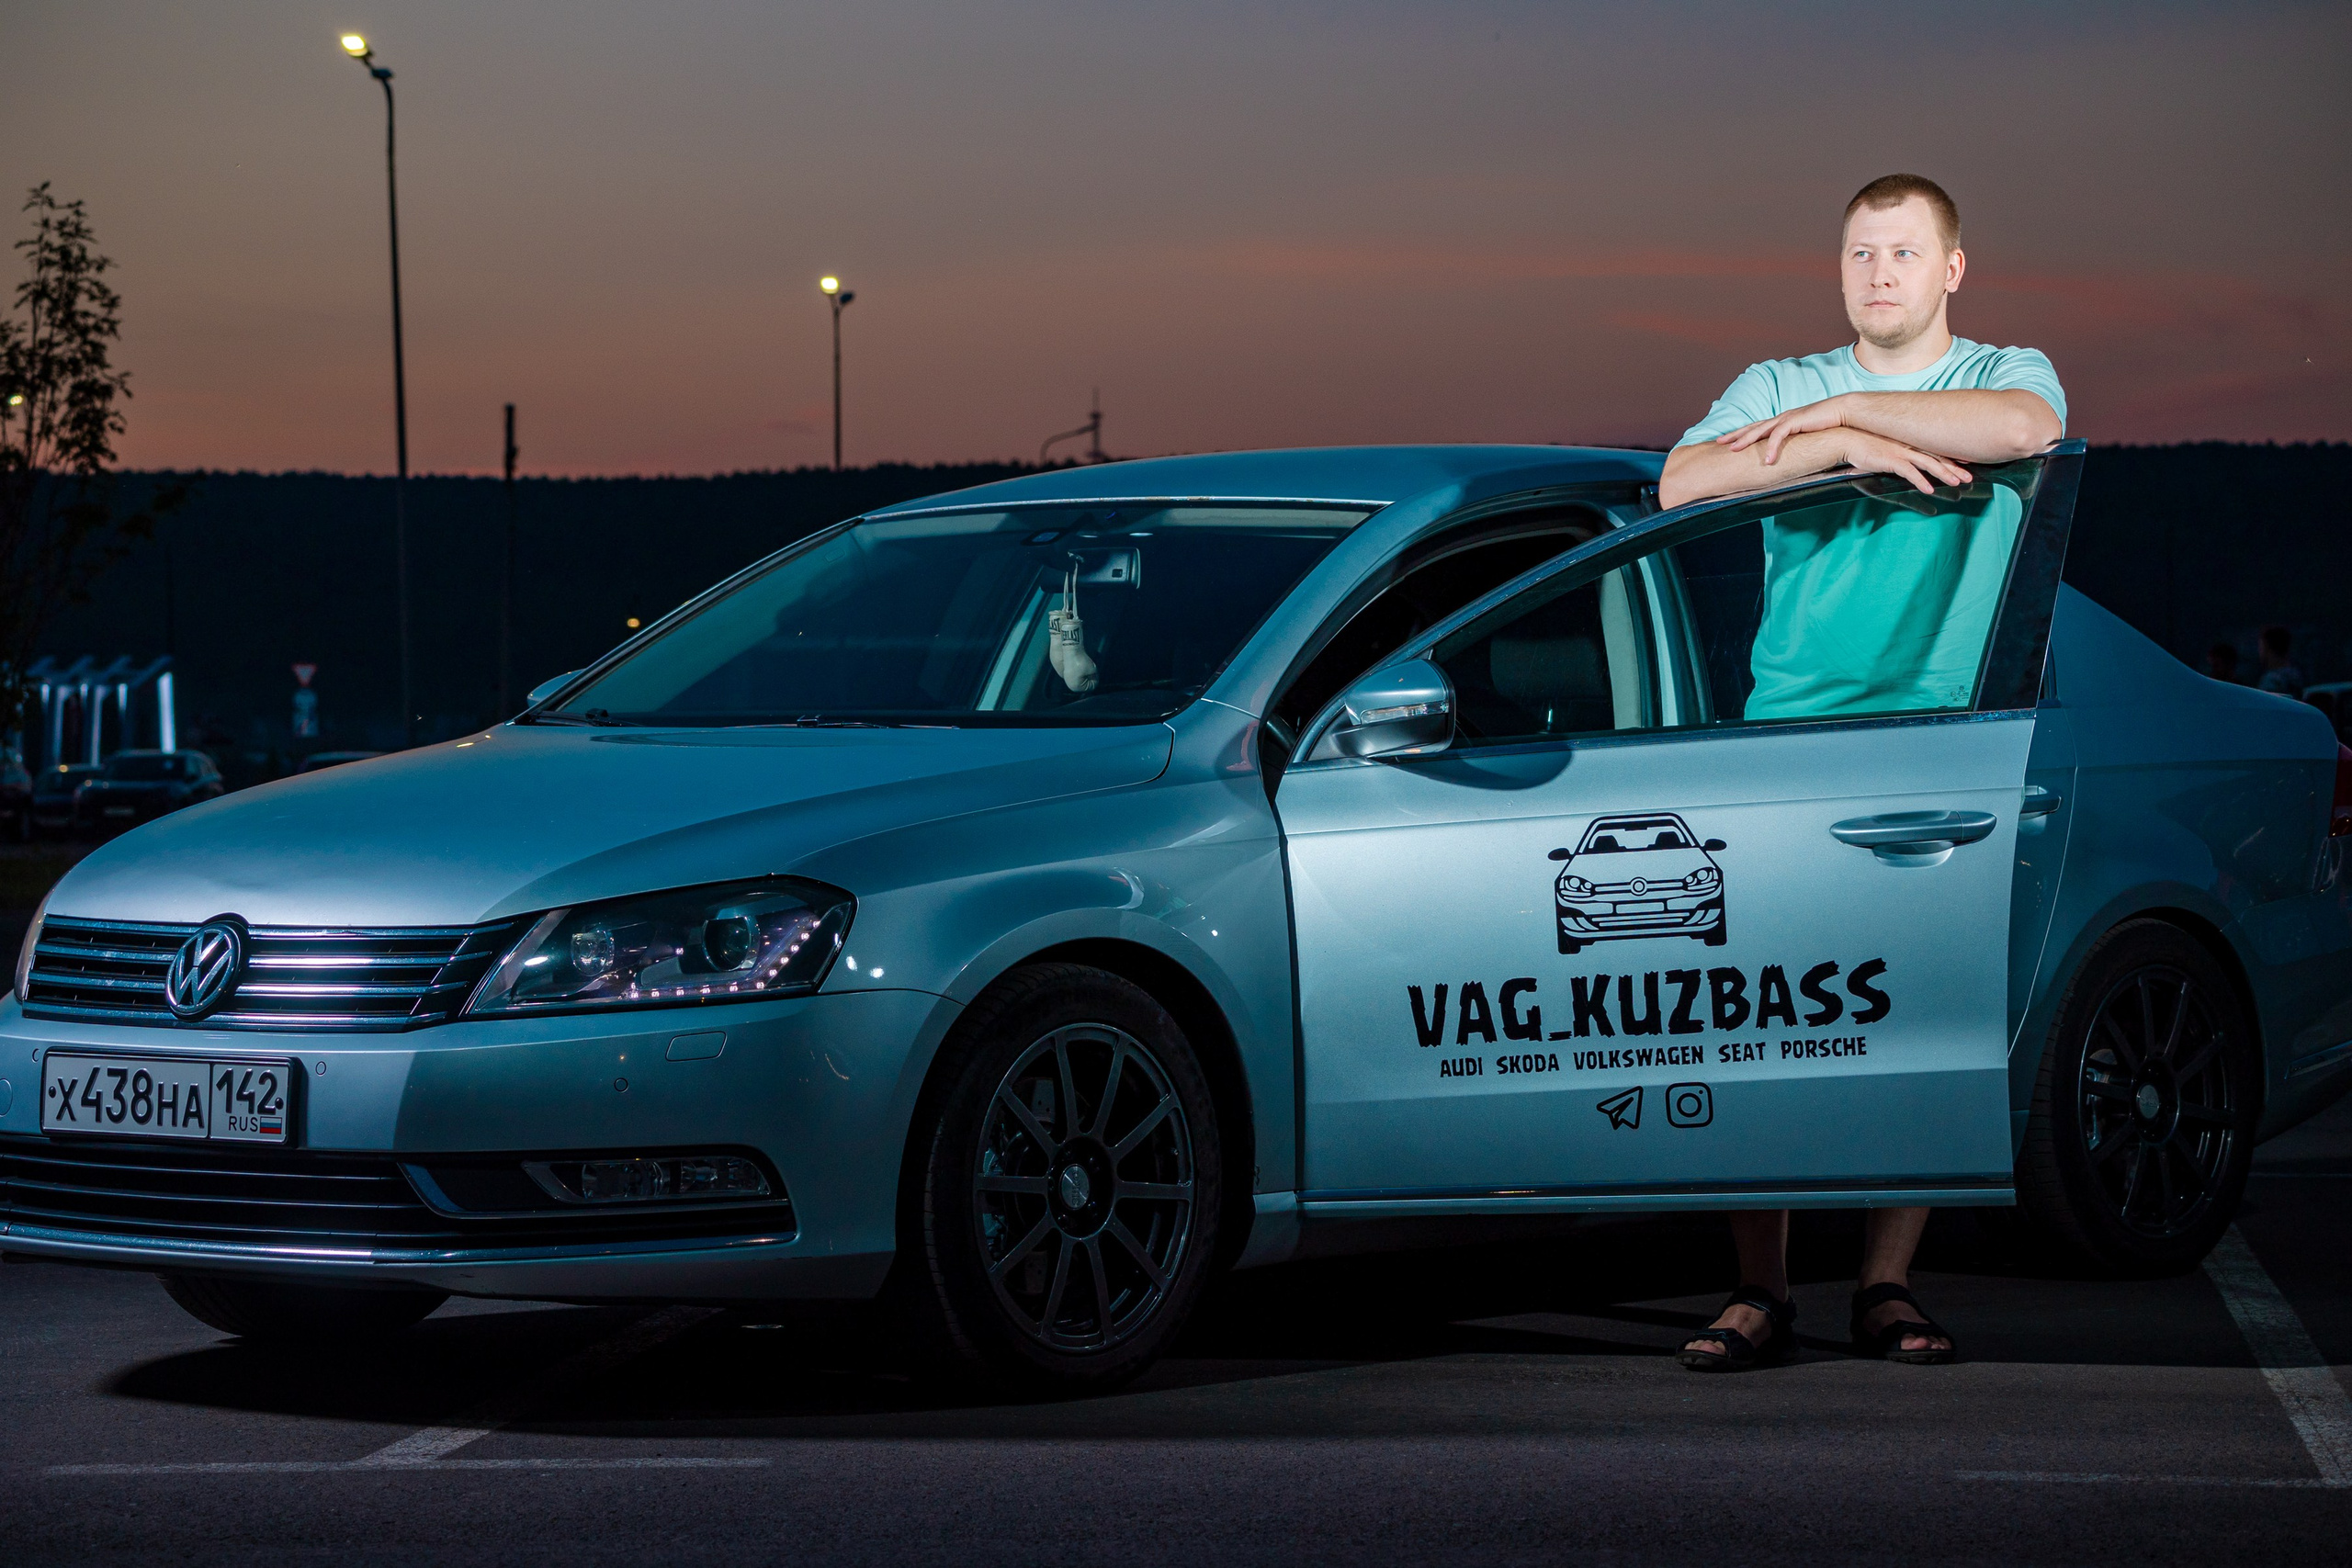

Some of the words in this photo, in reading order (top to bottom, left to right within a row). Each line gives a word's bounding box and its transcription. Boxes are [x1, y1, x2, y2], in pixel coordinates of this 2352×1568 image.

[1408, 957, 1891, 1048] VAG_KUZBASS
[1440, 1057, 1483, 1077] AUDI
[1497, 1052, 1560, 1074] SKODA
[1573, 1045, 1704, 1070] VOLKSWAGEN
[1718, 1042, 1766, 1063] SEAT
[1781, 1036, 1867, 1059] PORSCHE
[216, 1068, 277, 1115] 142
[228, 1116, 258, 1133] RUS
